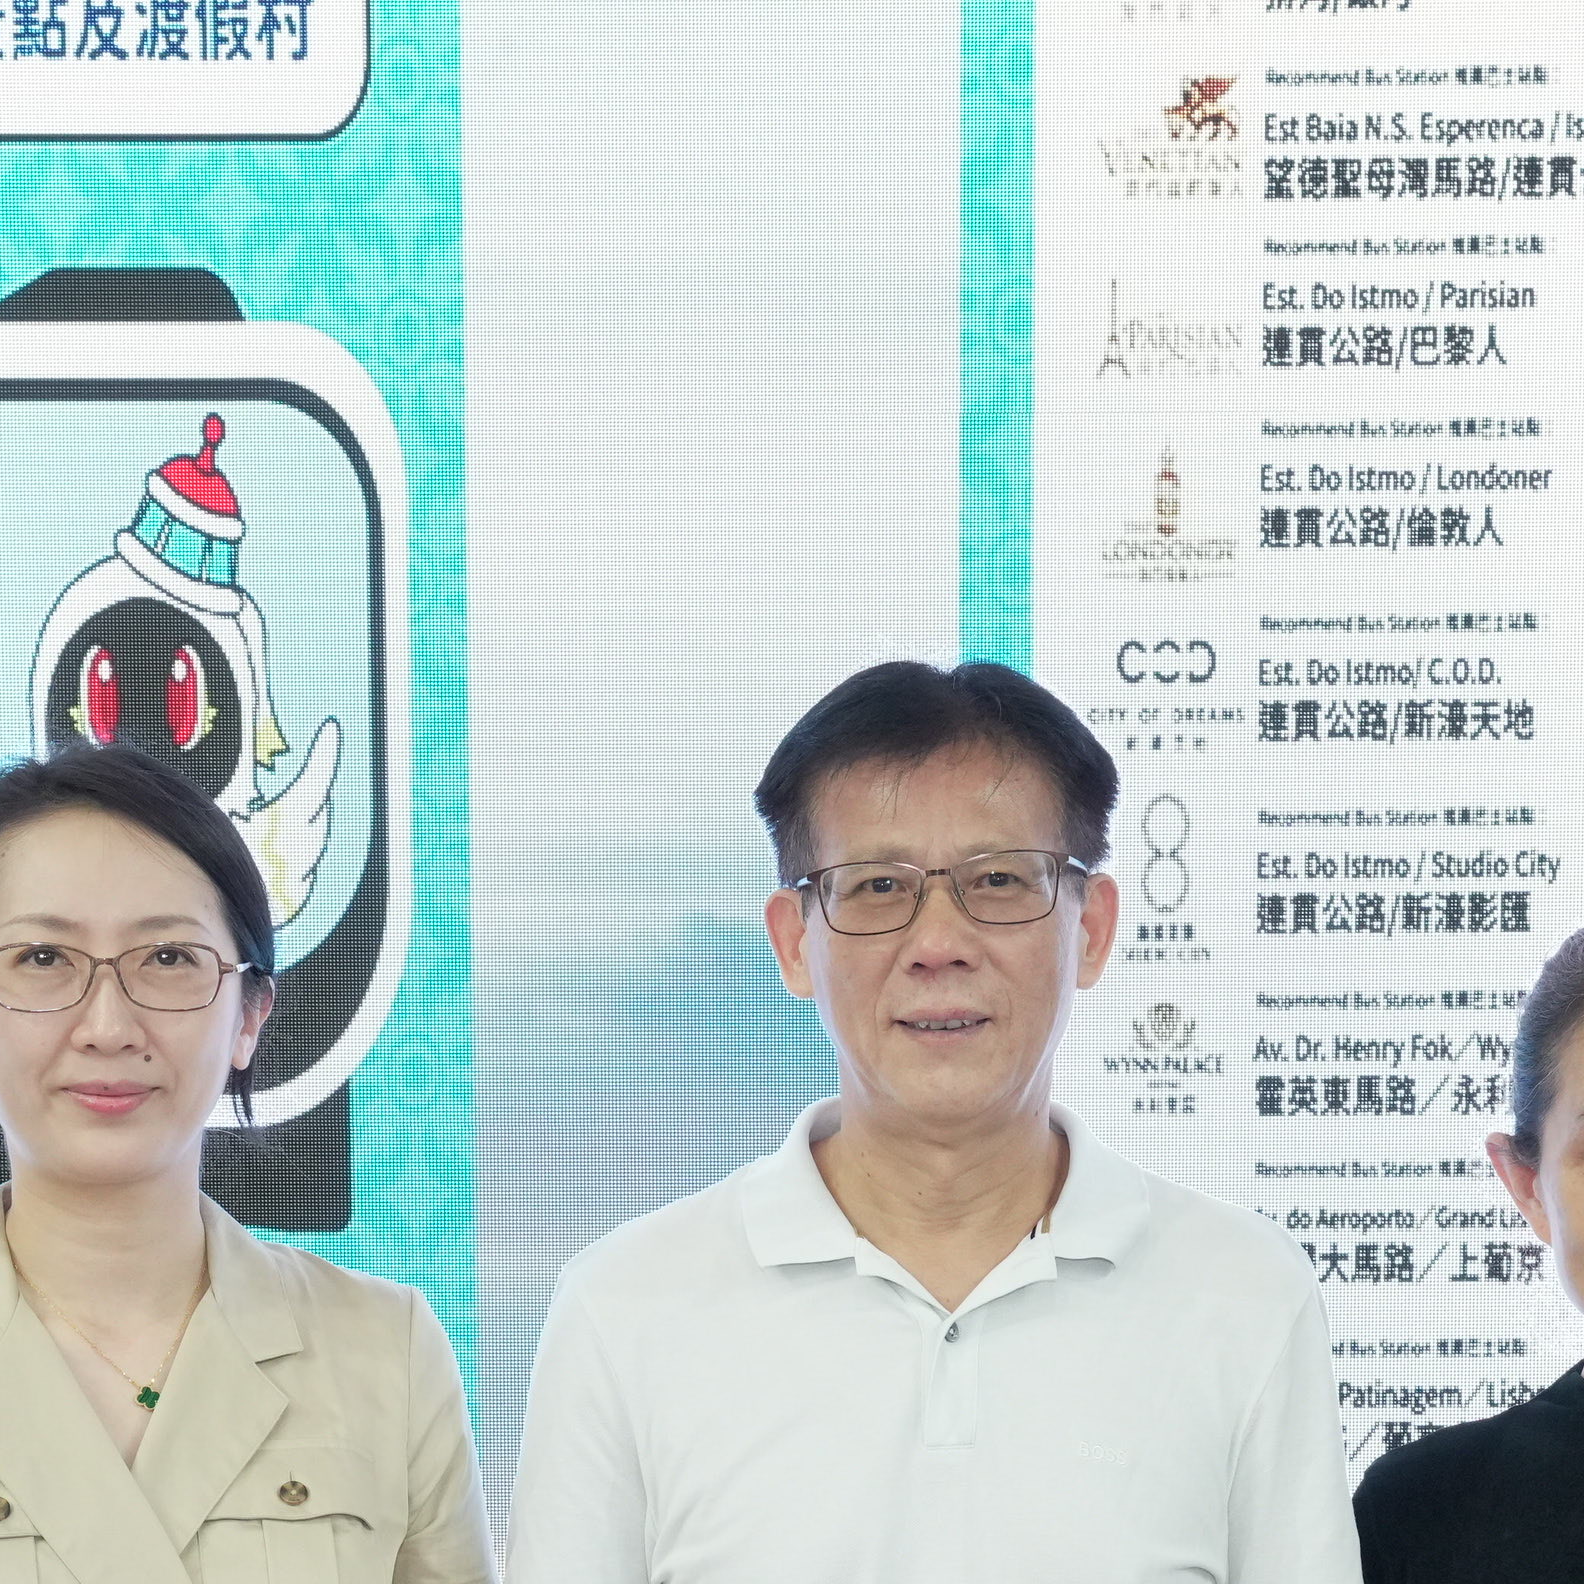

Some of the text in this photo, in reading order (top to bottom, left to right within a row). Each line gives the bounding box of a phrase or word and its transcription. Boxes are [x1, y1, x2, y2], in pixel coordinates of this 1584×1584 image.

[1263, 112, 1300, 142] Est
[1306, 112, 1358, 142] Baia
[1365, 112, 1414, 142] N.S.
[1420, 112, 1544, 147] Esperenca
[1262, 280, 1539, 311] Est. Do Istmo Parisian
[1436, 462, 1554, 493] Londoner
[1427, 658, 1503, 687] C.O.D.
[1432, 849, 1561, 884] Studio City
[1253, 1034, 1405, 1068] Av. Dr. Henry
